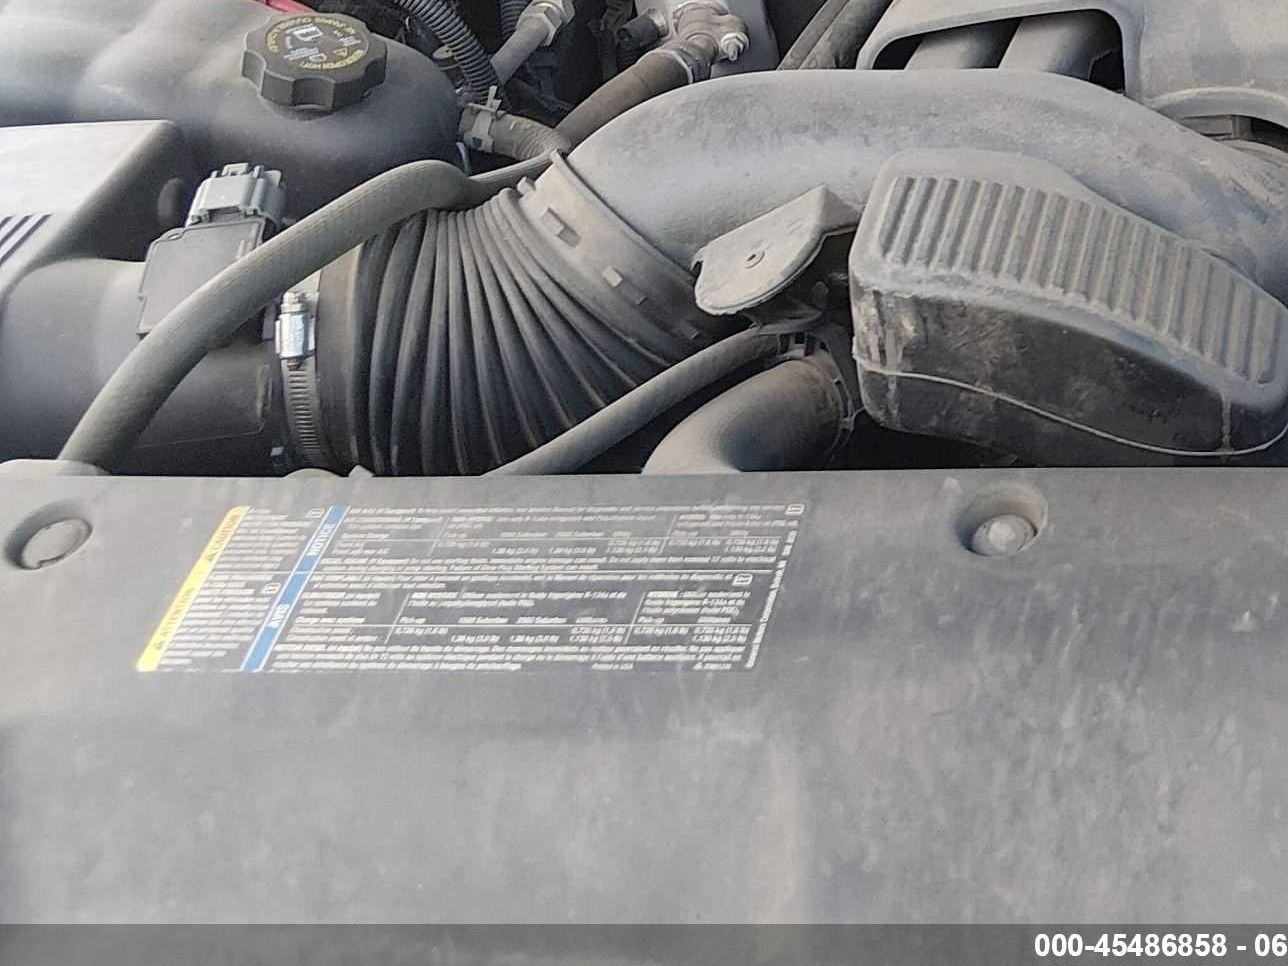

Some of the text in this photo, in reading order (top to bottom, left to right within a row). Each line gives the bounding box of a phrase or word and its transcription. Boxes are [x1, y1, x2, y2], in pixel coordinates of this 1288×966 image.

[306, 523, 336, 556] NOTICE
[163, 587, 195, 635] ATTENTION
[267, 603, 290, 628] AVIS
